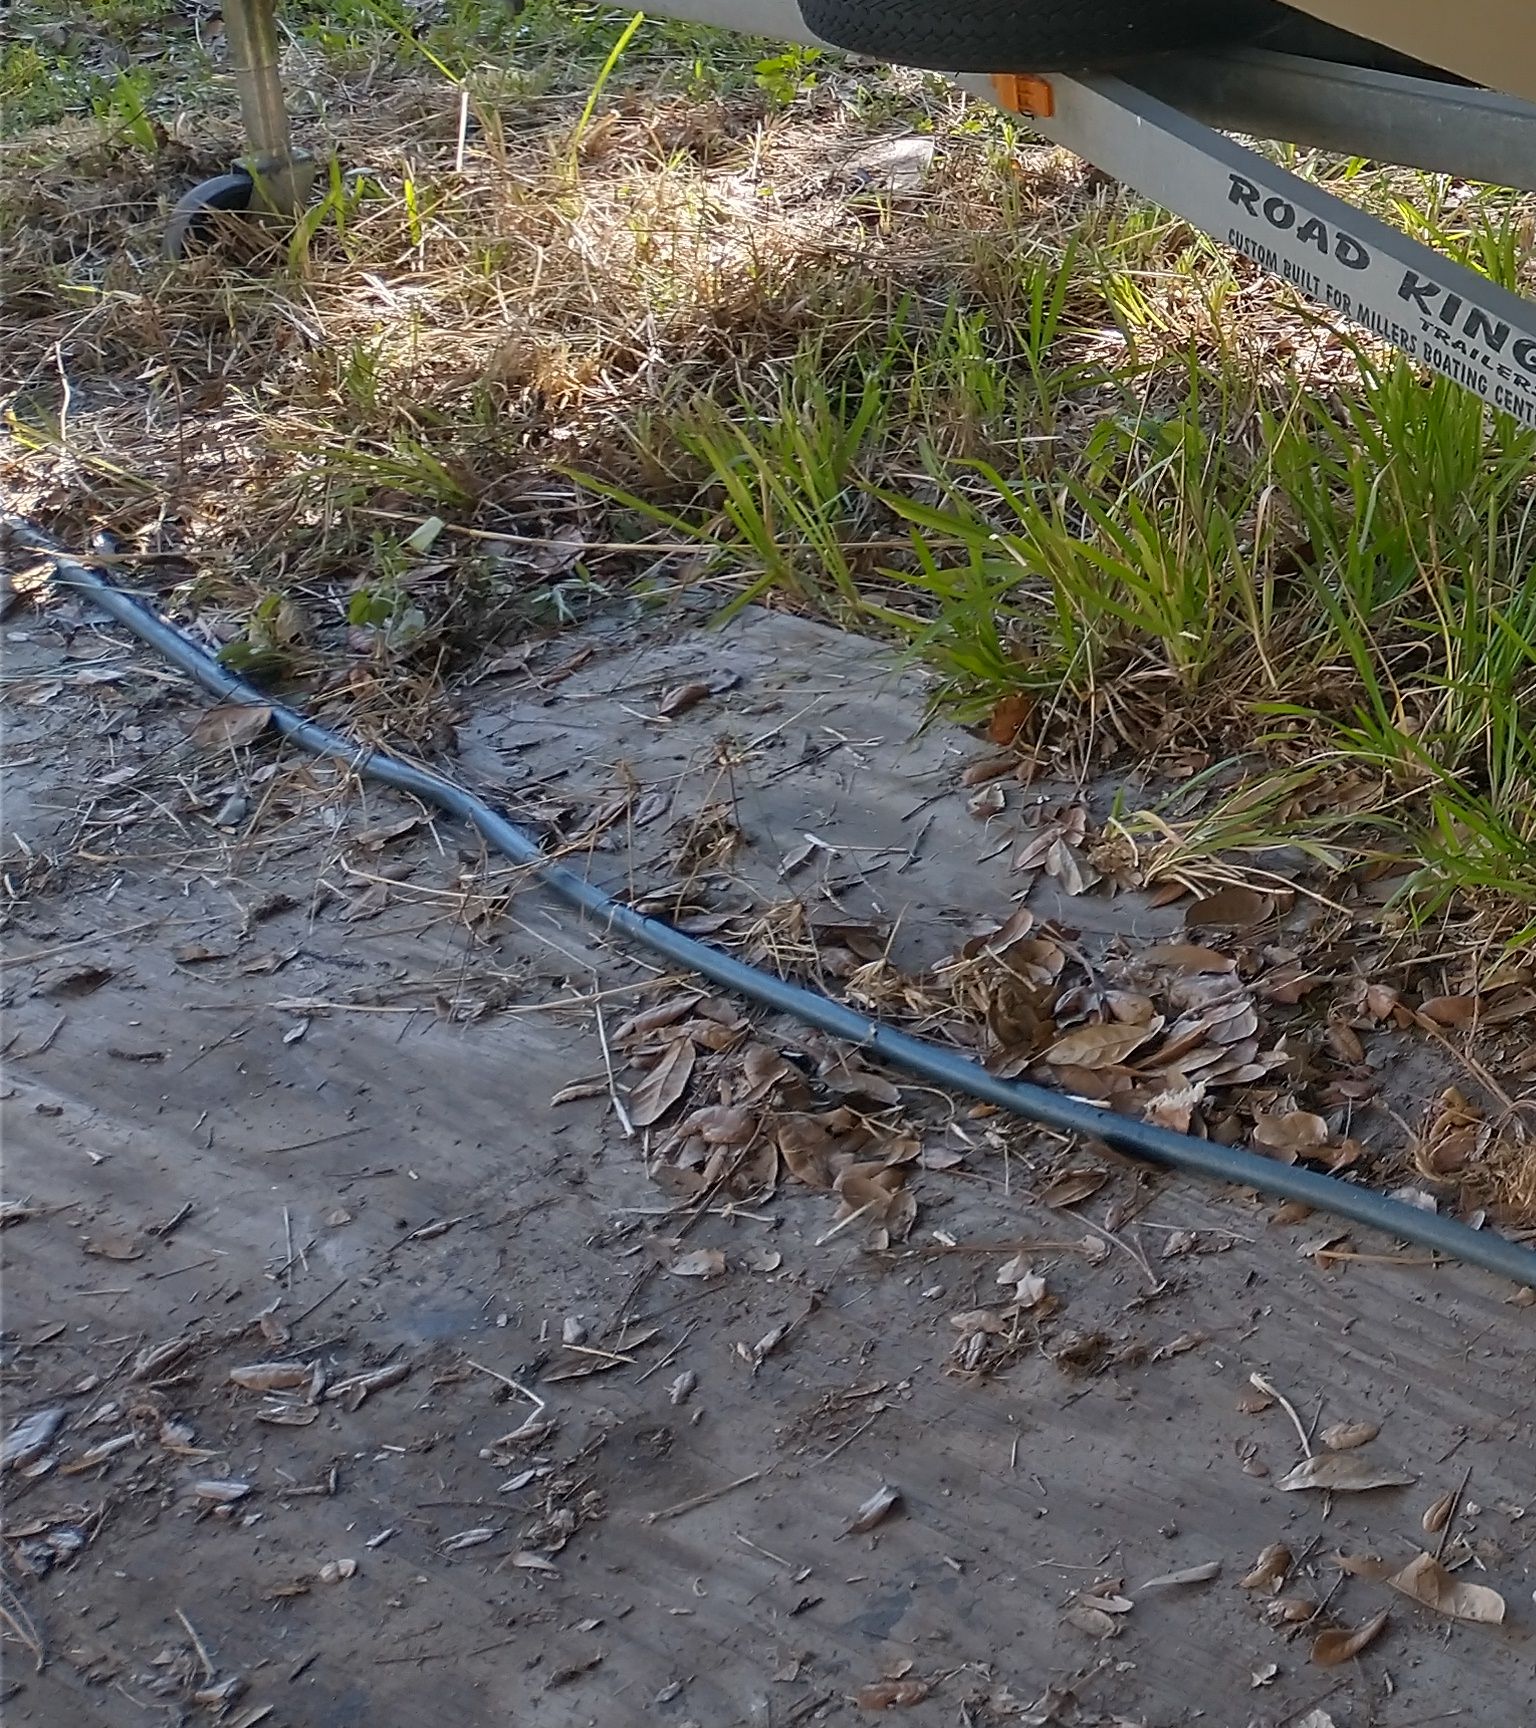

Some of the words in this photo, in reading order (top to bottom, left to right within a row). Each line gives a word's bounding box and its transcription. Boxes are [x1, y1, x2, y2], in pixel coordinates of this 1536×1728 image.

[1227, 173, 1370, 270] ROAD
[1228, 228, 1278, 272] CUSTOM
[1283, 259, 1320, 295] BUILT
[1326, 284, 1352, 316] FOR
[1357, 303, 1417, 354] MILLERS
[1423, 342, 1488, 395] BOATING
